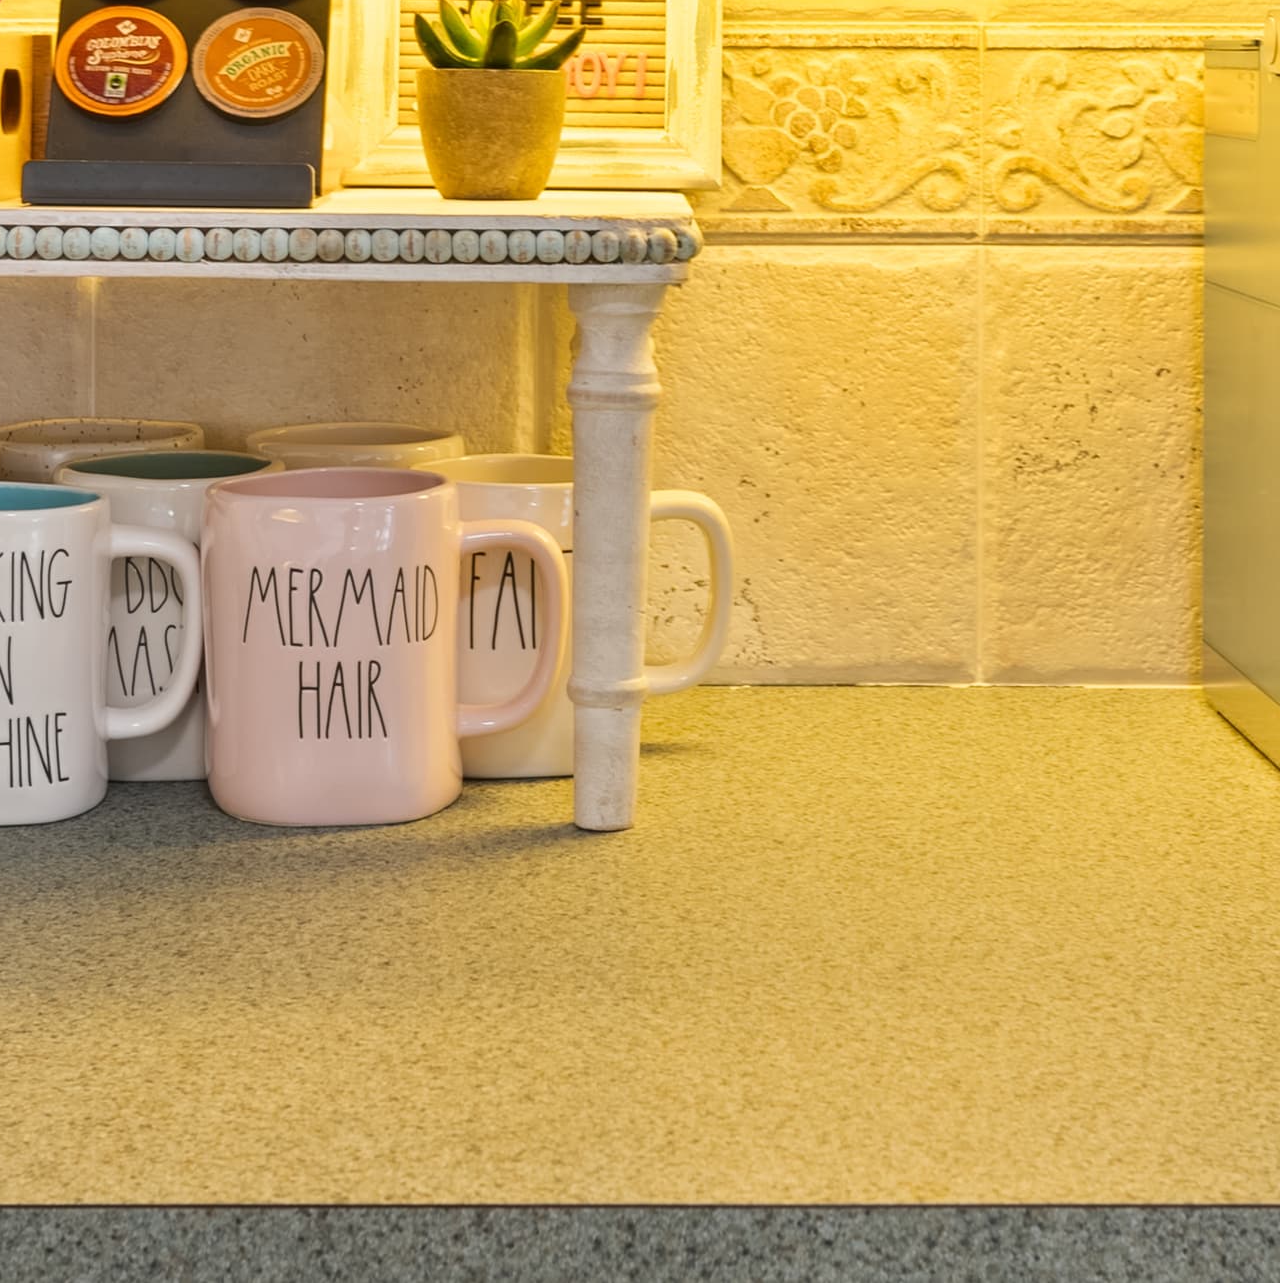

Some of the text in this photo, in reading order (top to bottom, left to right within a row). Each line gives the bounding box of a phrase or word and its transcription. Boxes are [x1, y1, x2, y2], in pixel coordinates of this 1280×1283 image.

[225, 44, 285, 76] ORGANIC
[247, 61, 280, 82] DARK
[248, 69, 289, 92] ROAST
[241, 563, 440, 648] MERMAID
[298, 659, 389, 740] HAIR
